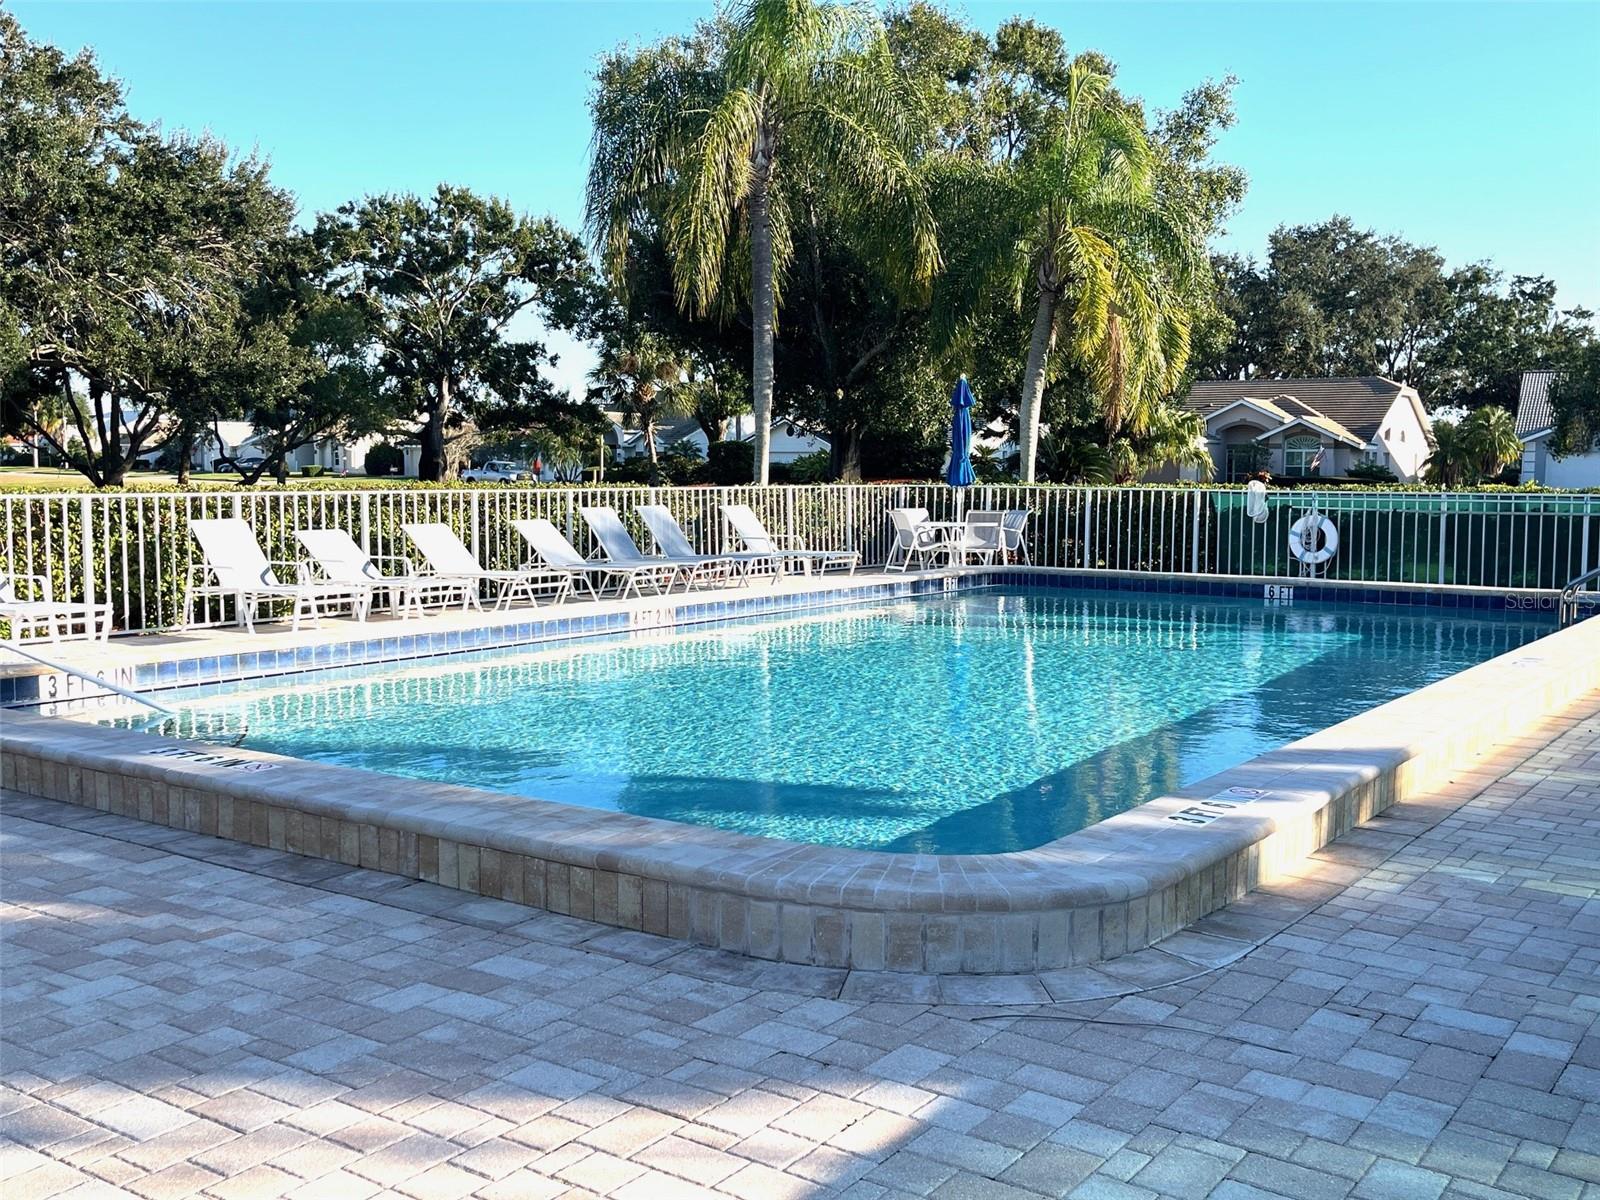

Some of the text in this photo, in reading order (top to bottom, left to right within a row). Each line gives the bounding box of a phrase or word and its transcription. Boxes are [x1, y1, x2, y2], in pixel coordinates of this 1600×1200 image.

[1268, 585, 1295, 599] 6 FT
[642, 610, 652, 624] FT
[656, 609, 661, 624] 2
[664, 607, 674, 622] IN
[48, 675, 57, 698] 3
[67, 670, 88, 696] FT
[115, 666, 132, 691] IN
[165, 751, 208, 759] FT
[210, 758, 253, 767] IN
[1201, 801, 1237, 809] 6
[1168, 816, 1207, 824] 3
[1179, 807, 1225, 819] FT
